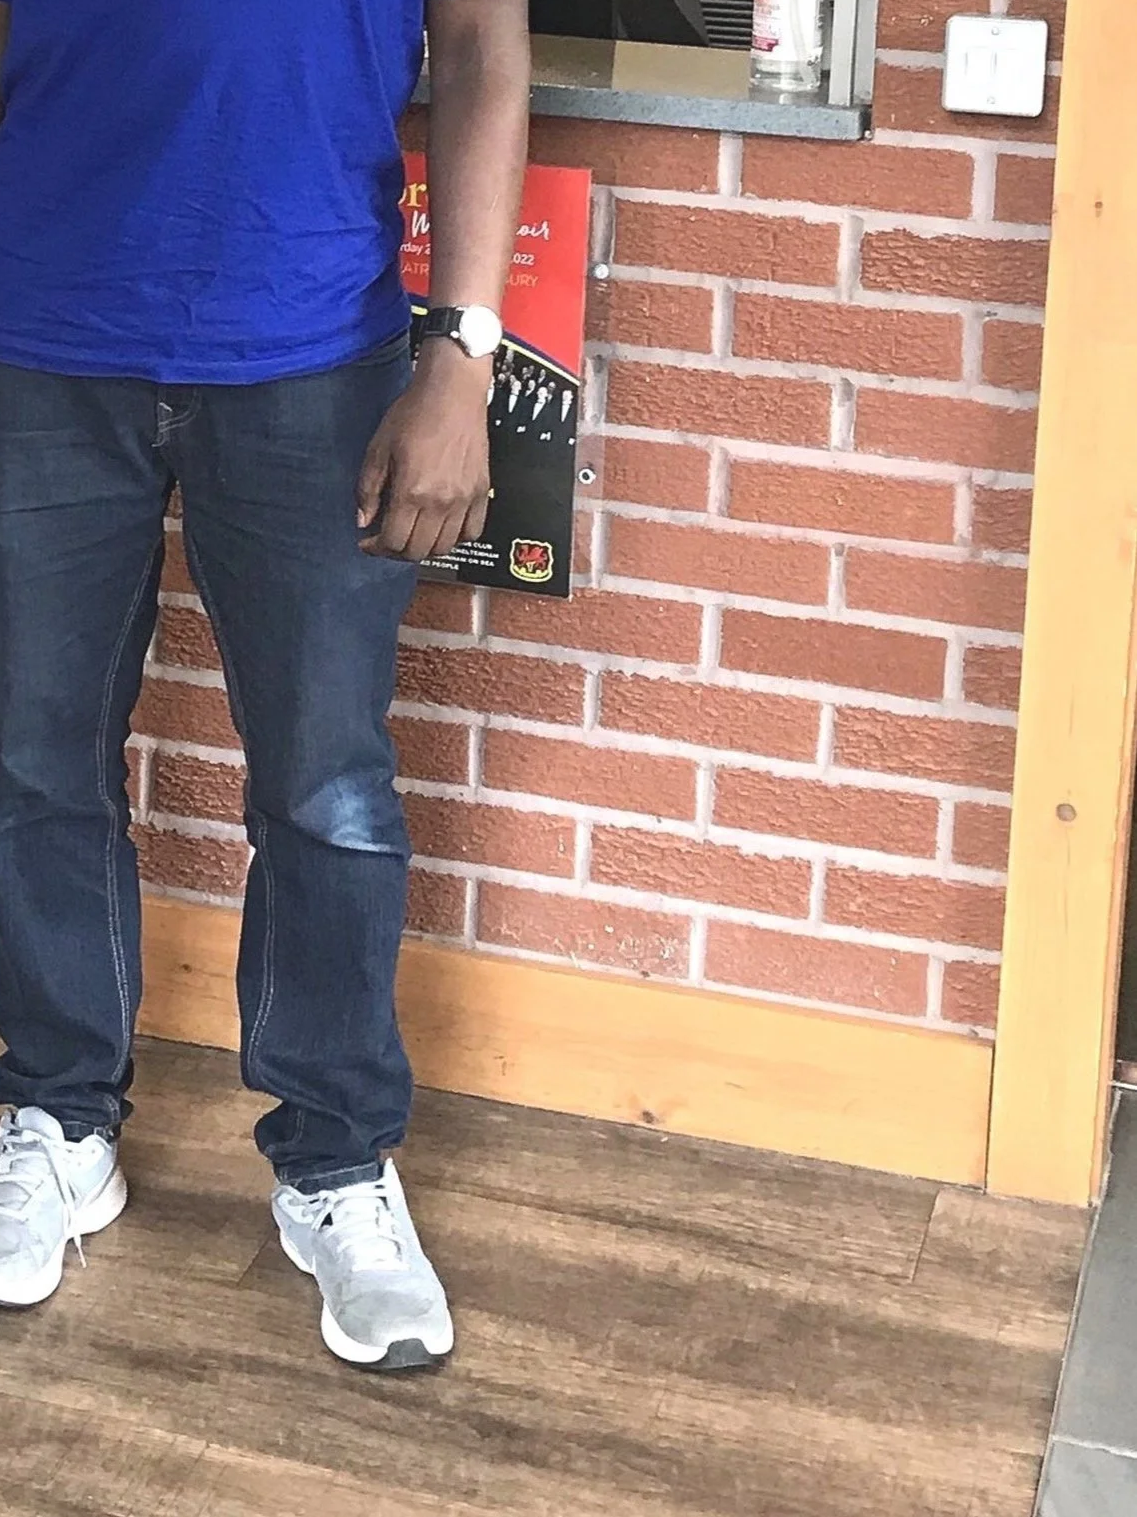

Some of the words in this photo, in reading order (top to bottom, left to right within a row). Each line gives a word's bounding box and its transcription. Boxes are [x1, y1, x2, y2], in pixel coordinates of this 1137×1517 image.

[511, 252, 536, 267] 022
[507, 272, 540, 288] URY
[431, 560, 460, 571] PEOPLE
